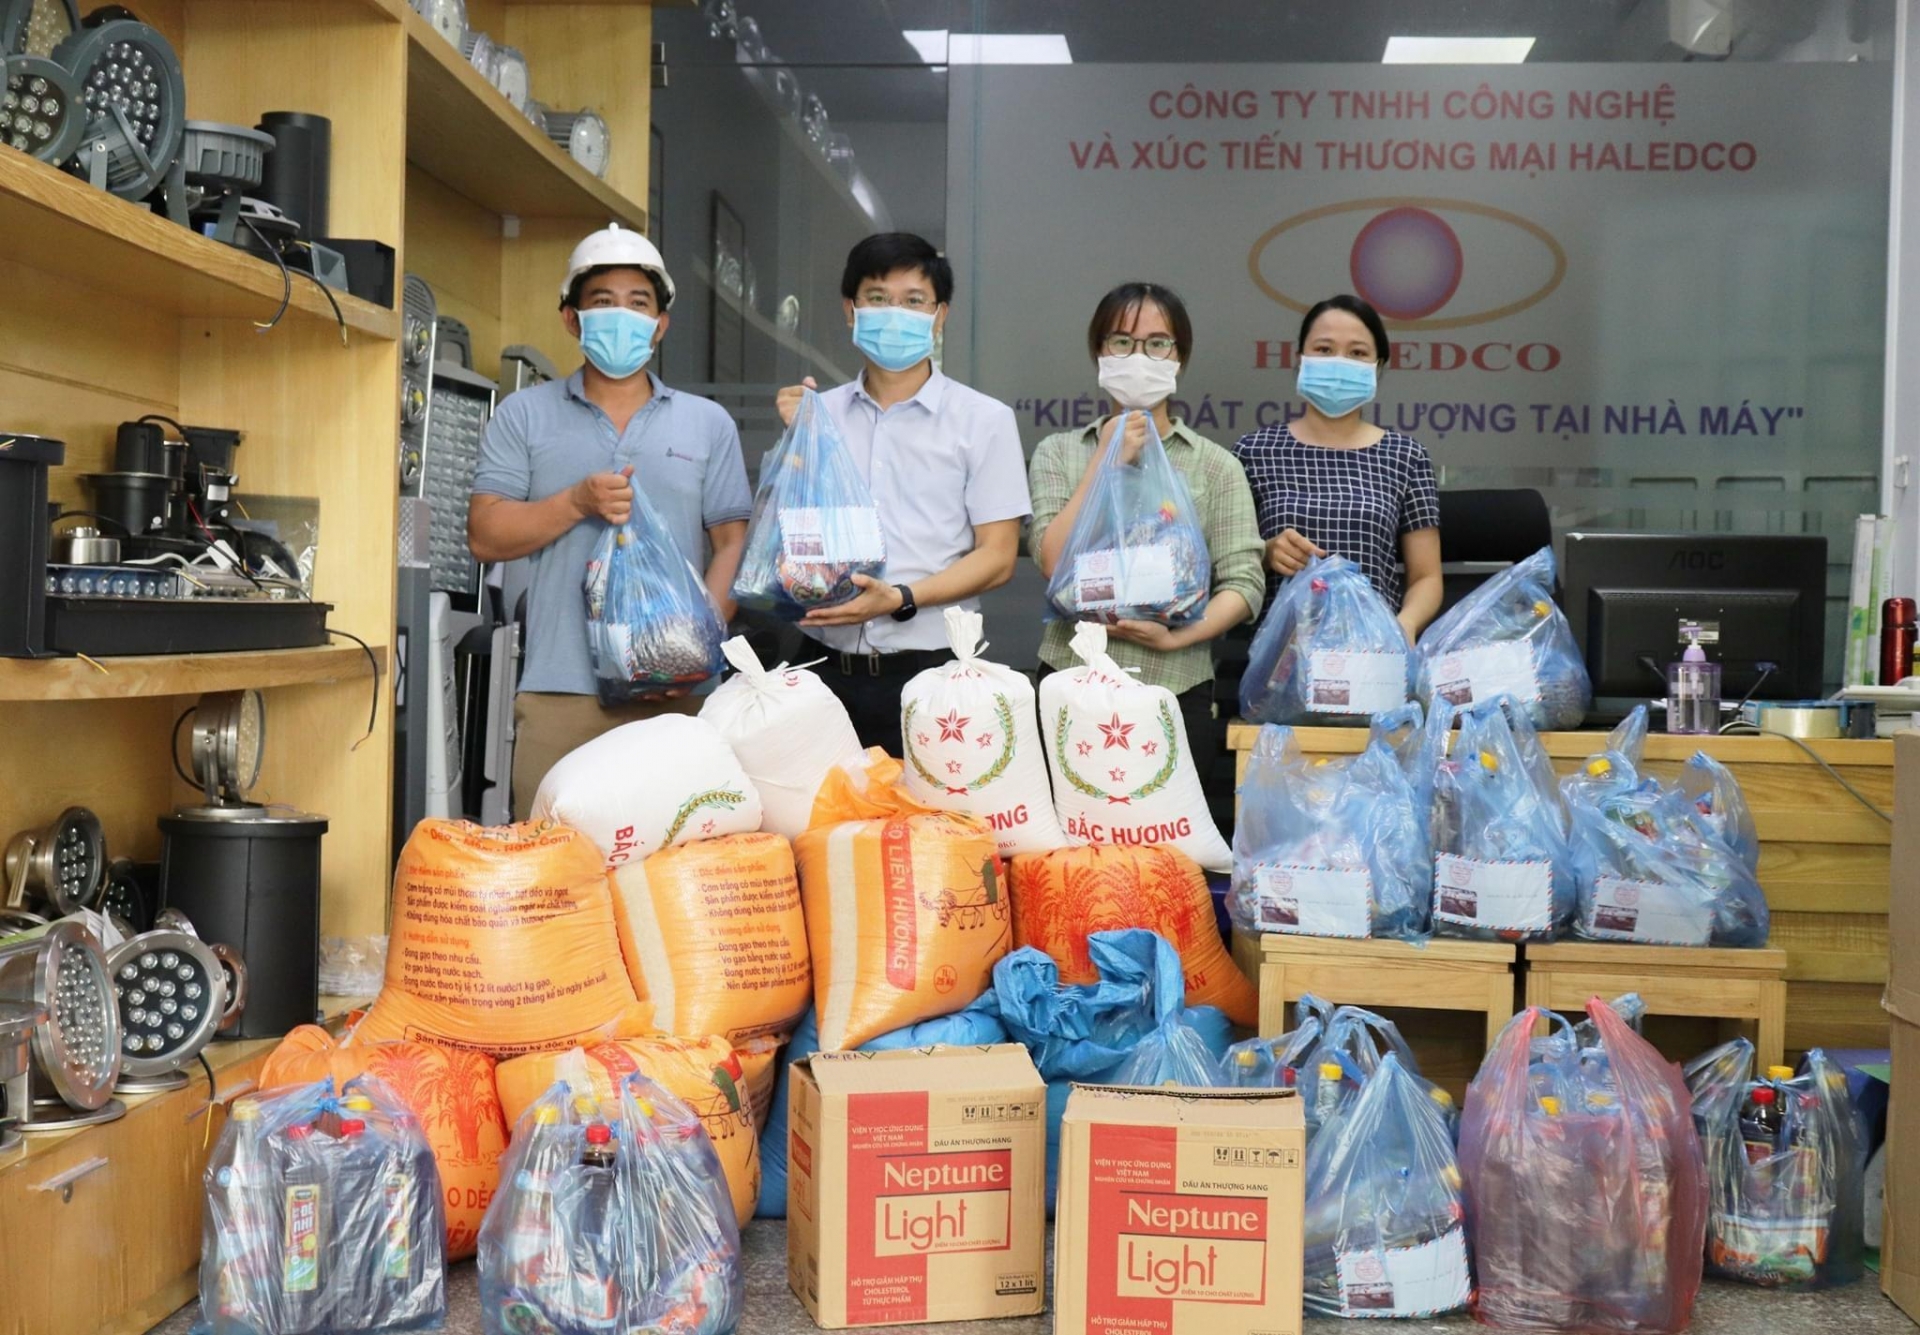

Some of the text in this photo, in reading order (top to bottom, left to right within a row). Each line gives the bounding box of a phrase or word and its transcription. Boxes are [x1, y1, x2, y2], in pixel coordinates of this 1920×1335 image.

[1149, 83, 1676, 127] CÔNG TY TNHH CÔNG NGHỆ
[1069, 129, 1757, 179] VÀ XÚC TIẾN THƯƠNG MẠI HALEDCO
[1253, 340, 1562, 373] HEDCO
[1373, 402, 1516, 439] LƯỢNG
[1529, 402, 1590, 441] TẠI
[1604, 398, 1687, 435] NHÀ
[1667, 550, 1725, 570] AOC
[1068, 811, 1192, 846] BẮC HƯƠNG
[889, 847, 910, 890] LIÊN
[892, 896, 911, 970] HƯƠNG
[884, 1162, 1004, 1191] Neptune
[885, 1199, 967, 1250] Light
[1128, 1199, 1259, 1233] Neptune
[1128, 1241, 1217, 1295] Light
[864, 1286, 910, 1296] CHOLESTEROL
